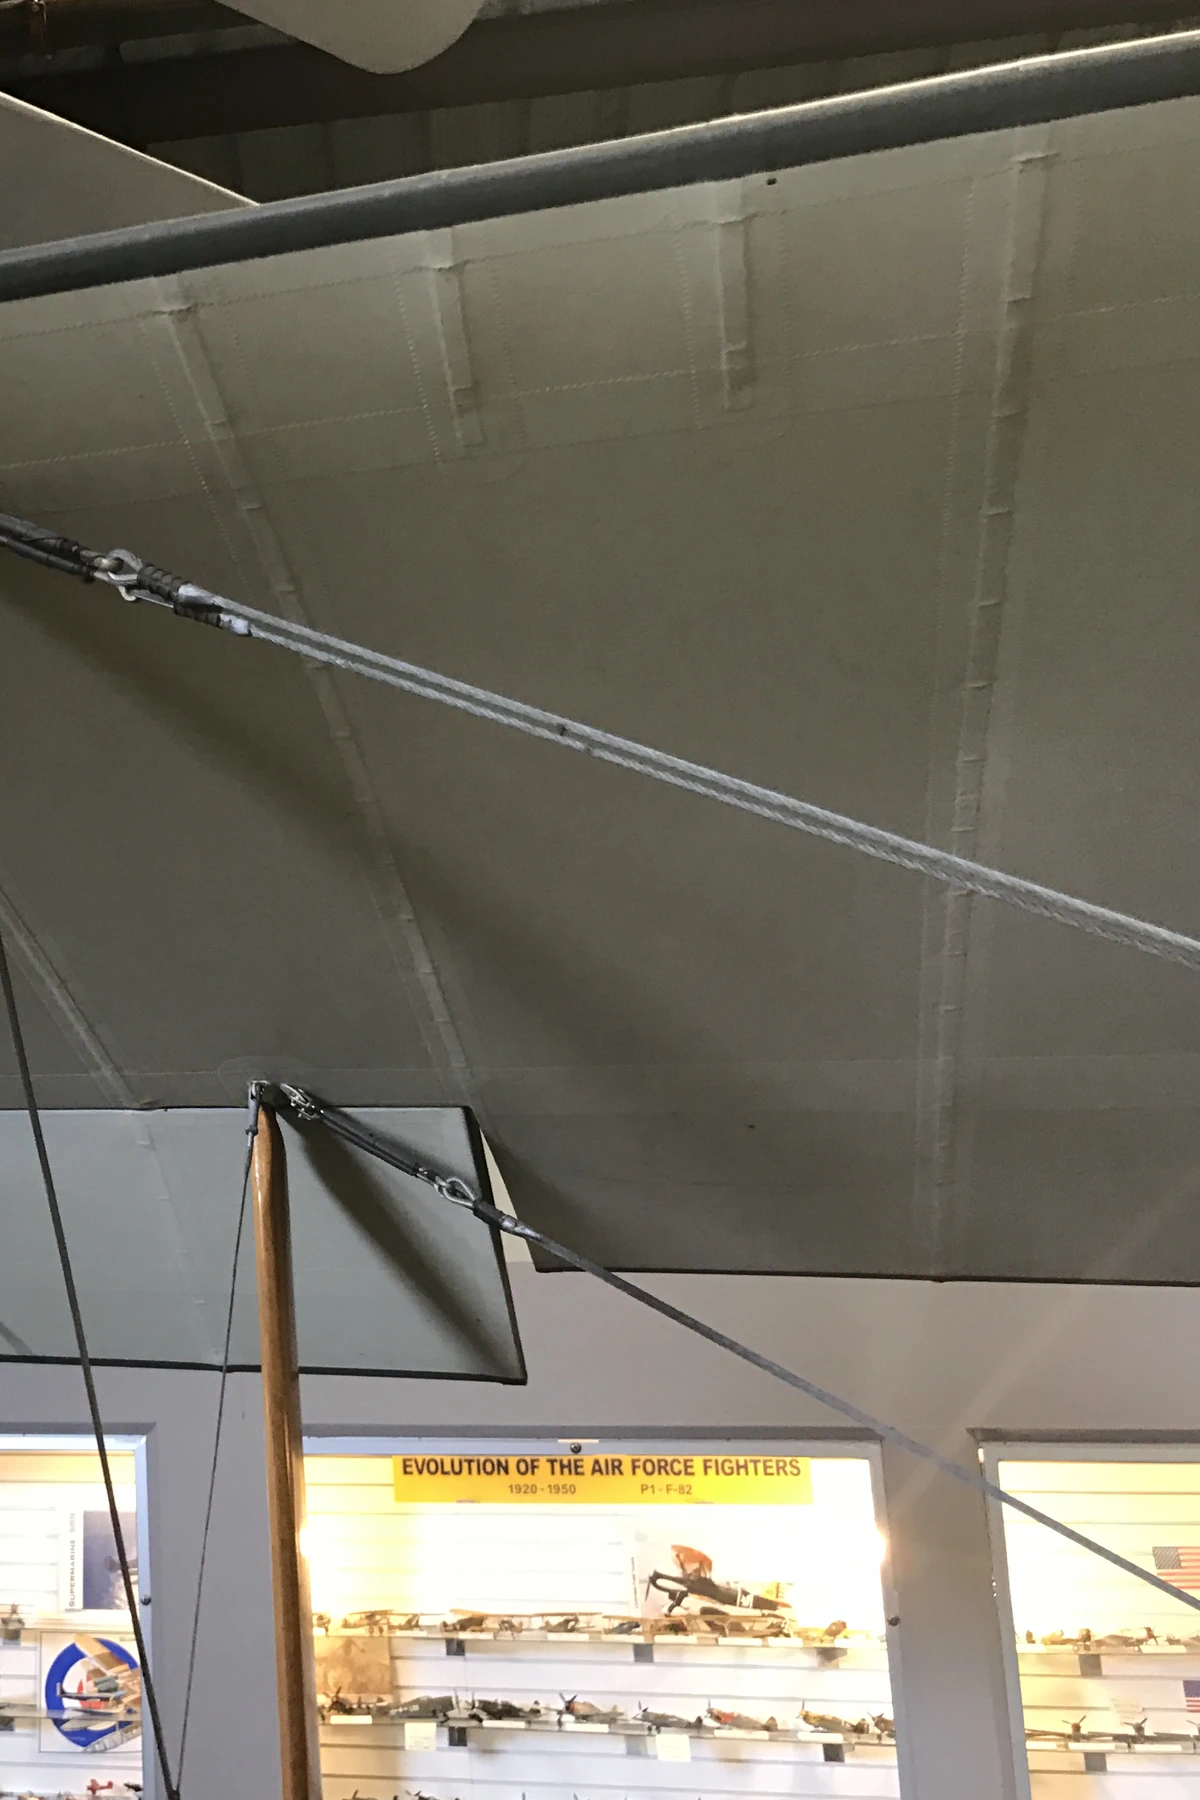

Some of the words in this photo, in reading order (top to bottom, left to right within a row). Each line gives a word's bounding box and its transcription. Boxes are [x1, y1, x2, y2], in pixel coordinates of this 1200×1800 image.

[402, 1457, 509, 1476] EVOLUTION
[516, 1458, 540, 1476] OF
[547, 1458, 585, 1476] THE
[590, 1458, 624, 1476] AIR
[631, 1458, 696, 1477] FORCE
[702, 1458, 802, 1477] FIGHTERS
[68, 1539, 76, 1608] SUPERMARINE
